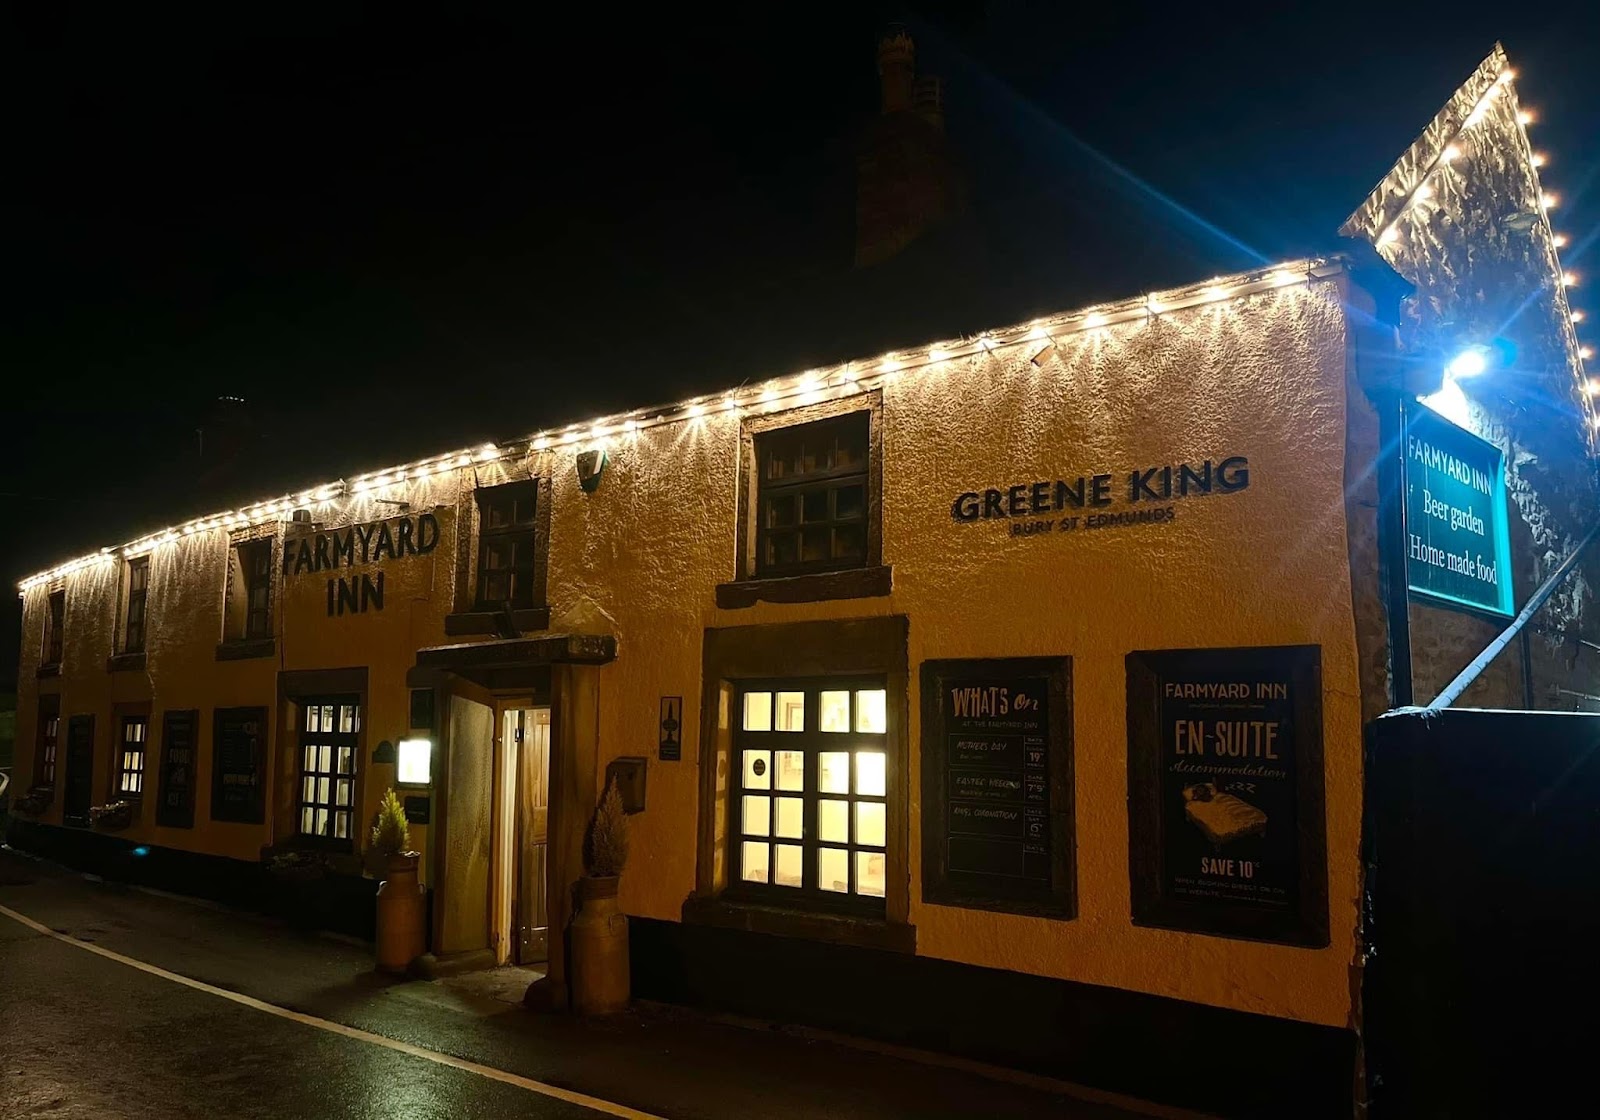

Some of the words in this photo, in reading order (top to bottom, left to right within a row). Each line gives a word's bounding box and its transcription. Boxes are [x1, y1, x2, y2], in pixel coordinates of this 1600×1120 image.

[1409, 434, 1470, 486] FARMYARD
[1472, 468, 1493, 497] INN
[952, 474, 1112, 524] GREENE
[1131, 456, 1249, 501] KING
[1012, 520, 1053, 536] BURY
[1060, 518, 1078, 531] ST
[1086, 507, 1175, 529] EDMUNDS
[1423, 489, 1448, 521] Beer
[1451, 506, 1485, 536] garden
[283, 513, 439, 575] FARMYARD
[1409, 534, 1445, 567] Home
[1447, 550, 1475, 578] made
[1476, 555, 1498, 585] food
[328, 572, 384, 616] INN
[951, 686, 1009, 718] WHATS
[1165, 683, 1250, 699] FARMYARD
[1256, 683, 1287, 700] INN
[991, 741, 1007, 751] DAY
[1201, 857, 1235, 877] SAVE
